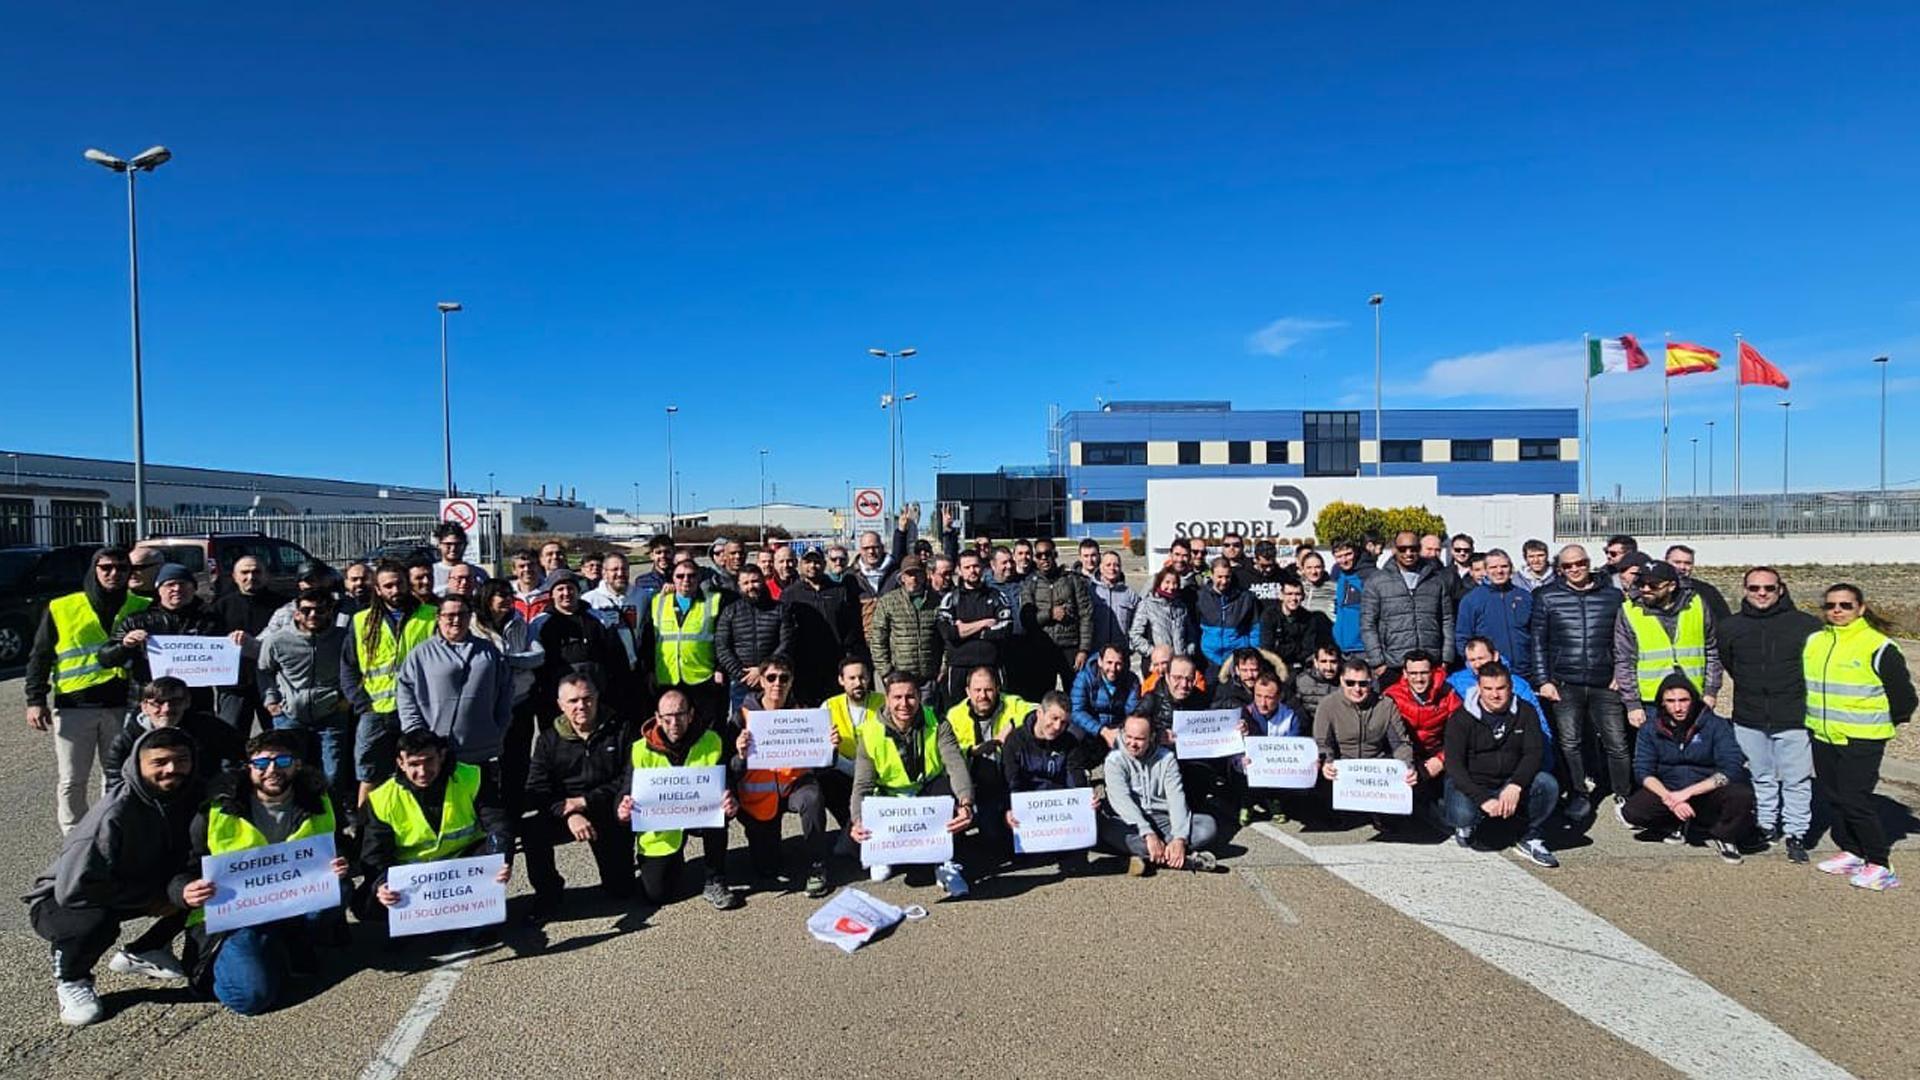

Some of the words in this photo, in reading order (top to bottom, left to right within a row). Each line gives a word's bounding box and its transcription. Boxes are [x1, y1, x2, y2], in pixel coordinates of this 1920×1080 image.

[1175, 521, 1279, 538] SOFIDEL
[163, 642, 204, 650] SOFIDEL
[172, 654, 213, 662] HUELGA
[1258, 743, 1290, 751] SOFIDEL
[1348, 764, 1382, 773] SOFIDEL
[1386, 766, 1398, 775] EN
[650, 776, 691, 786] SOFIDEL
[696, 775, 710, 784] EN
[1356, 778, 1389, 787] HUELGA
[659, 791, 700, 802] HUELGA
[1027, 798, 1064, 809] SOFIDEL
[1067, 797, 1080, 806] EN
[878, 806, 917, 817] SOFIDEL
[923, 806, 936, 815] EN
[1036, 812, 1073, 823] HUELGA
[888, 822, 927, 833] HUELGA
[229, 853, 288, 873] SOFIDEL
[295, 847, 314, 860] EN
[244, 869, 302, 889] HUELGA
[410, 870, 461, 885] SOFIDEL
[468, 866, 485, 877] EN
[236, 887, 298, 910] SOLUCIÓN
[301, 881, 330, 896] YA!!!
[424, 885, 474, 901] HUELGA
[414, 902, 469, 918] SOLUCIÓN
[471, 897, 497, 910] YA!!!
